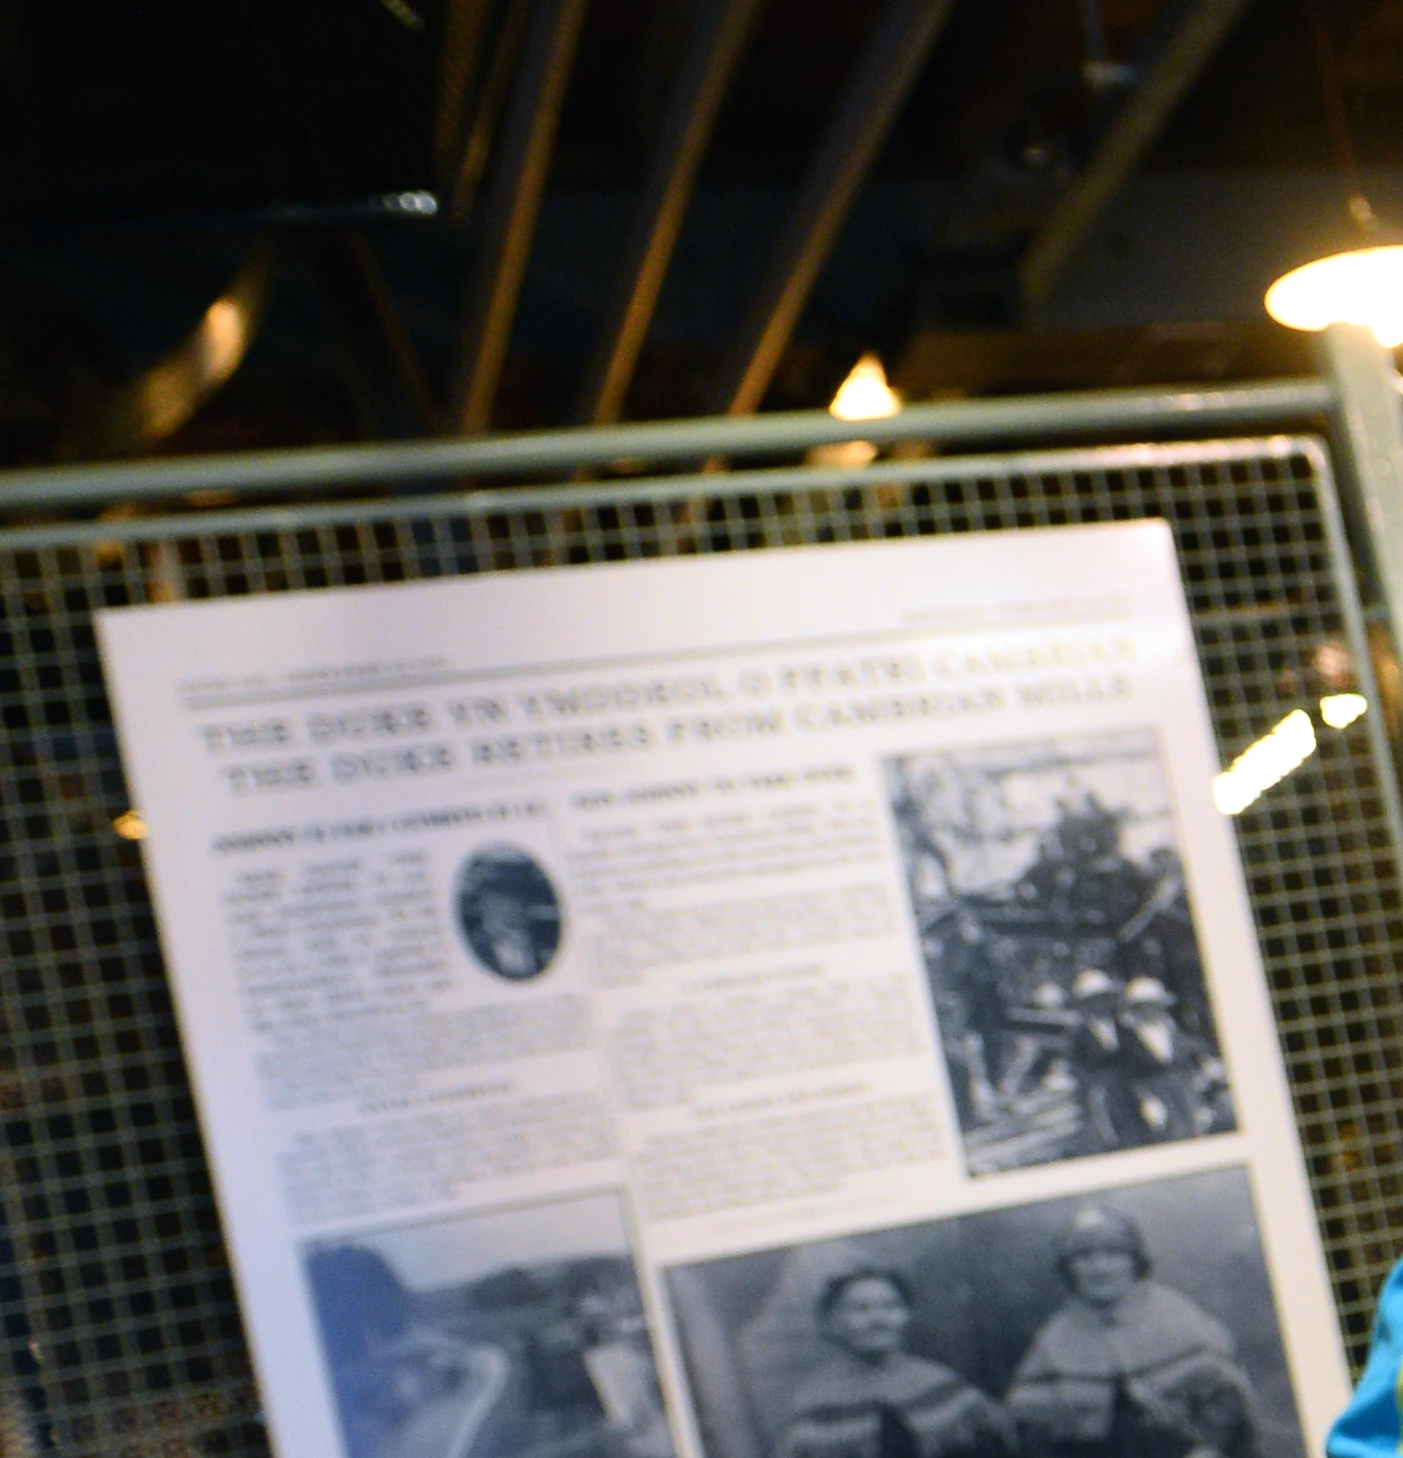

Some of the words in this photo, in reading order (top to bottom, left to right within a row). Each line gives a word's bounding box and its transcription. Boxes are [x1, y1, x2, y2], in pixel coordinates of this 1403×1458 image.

[203, 721, 291, 756] THE
[305, 703, 434, 744] DUKE
[225, 759, 317, 795] THE
[329, 743, 456, 784] DUKE
[471, 722, 656, 765] RETIRES
[665, 707, 785, 746] FROM
[792, 682, 1006, 733] CAMBRIAN
[1016, 670, 1134, 708] MILLS
